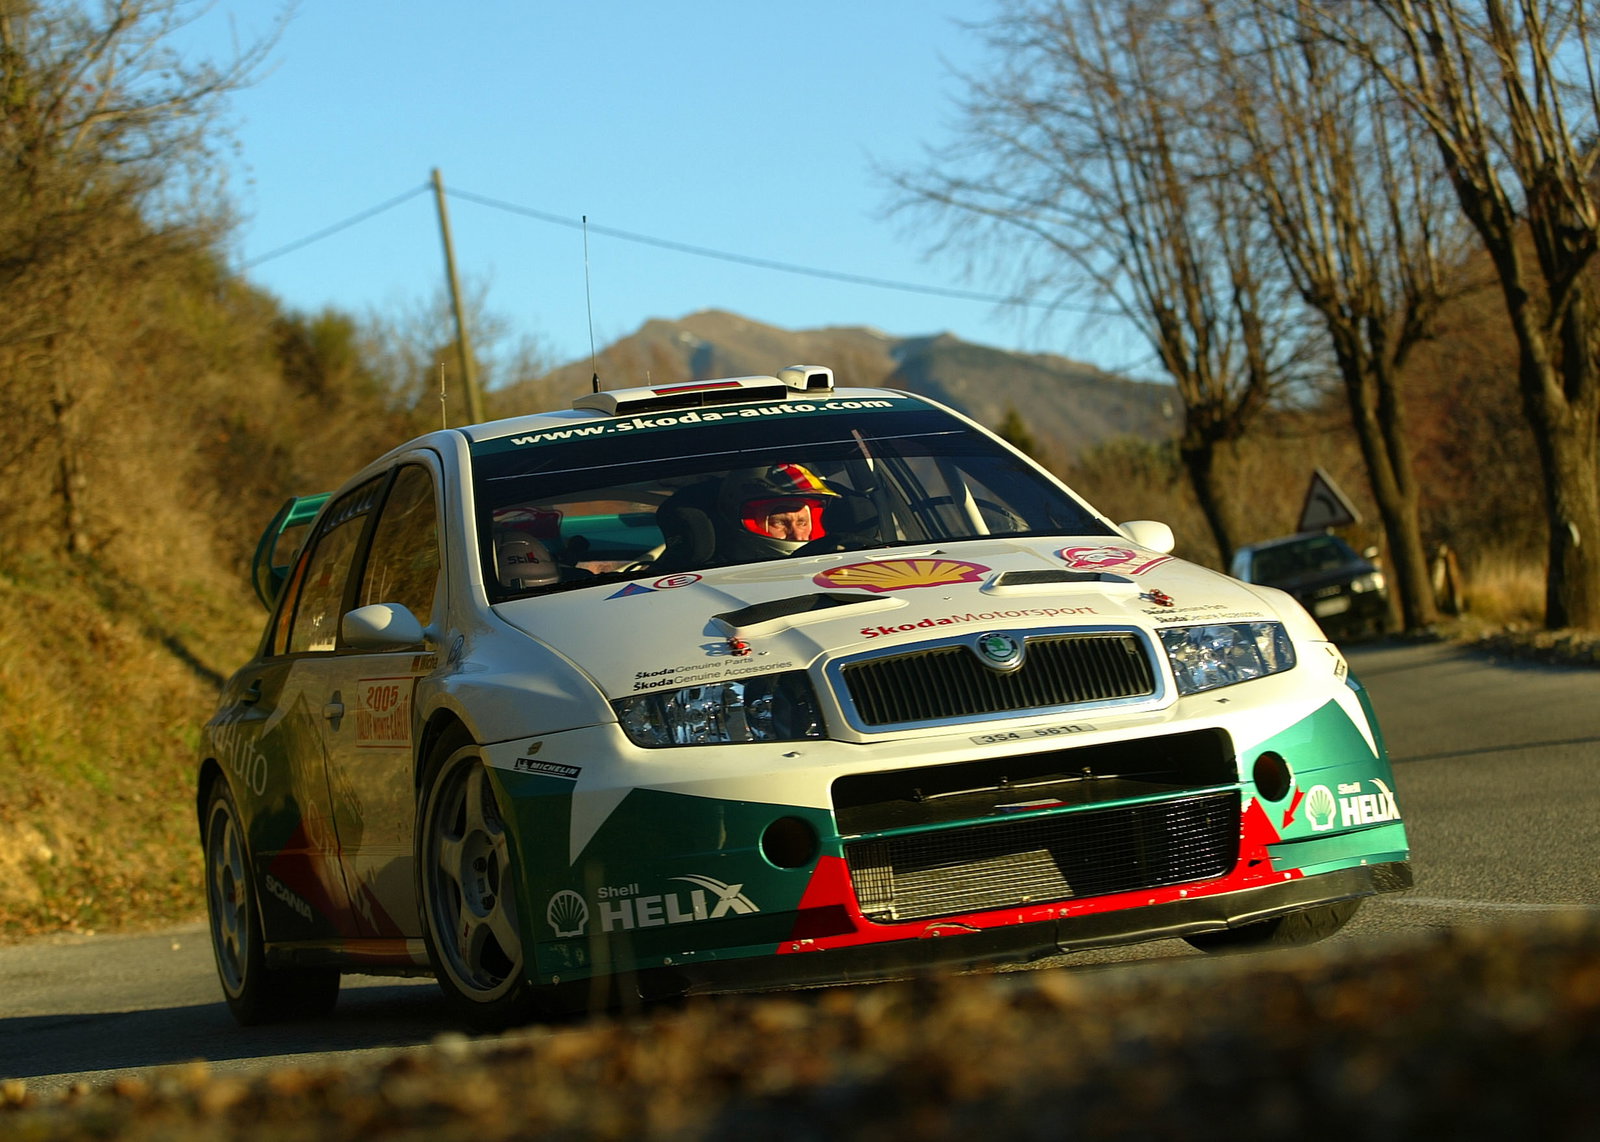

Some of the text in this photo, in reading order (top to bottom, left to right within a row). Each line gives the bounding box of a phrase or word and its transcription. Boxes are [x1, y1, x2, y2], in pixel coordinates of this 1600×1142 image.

[510, 397, 893, 446] www.skoda-auto.com
[859, 606, 1099, 639] ŠkodaMotorsport
[632, 660, 793, 692] ŠkodaGenuine Accessories
[634, 656, 754, 680] ŠkodaGenuine Parts
[366, 685, 400, 712] 2005
[1034, 725, 1083, 737] 5611
[530, 761, 579, 775] MICHELIN
[1338, 778, 1402, 827] HELIX
[264, 873, 313, 923] SCANIA
[597, 882, 640, 899] Shell
[598, 873, 761, 932] HELIX
